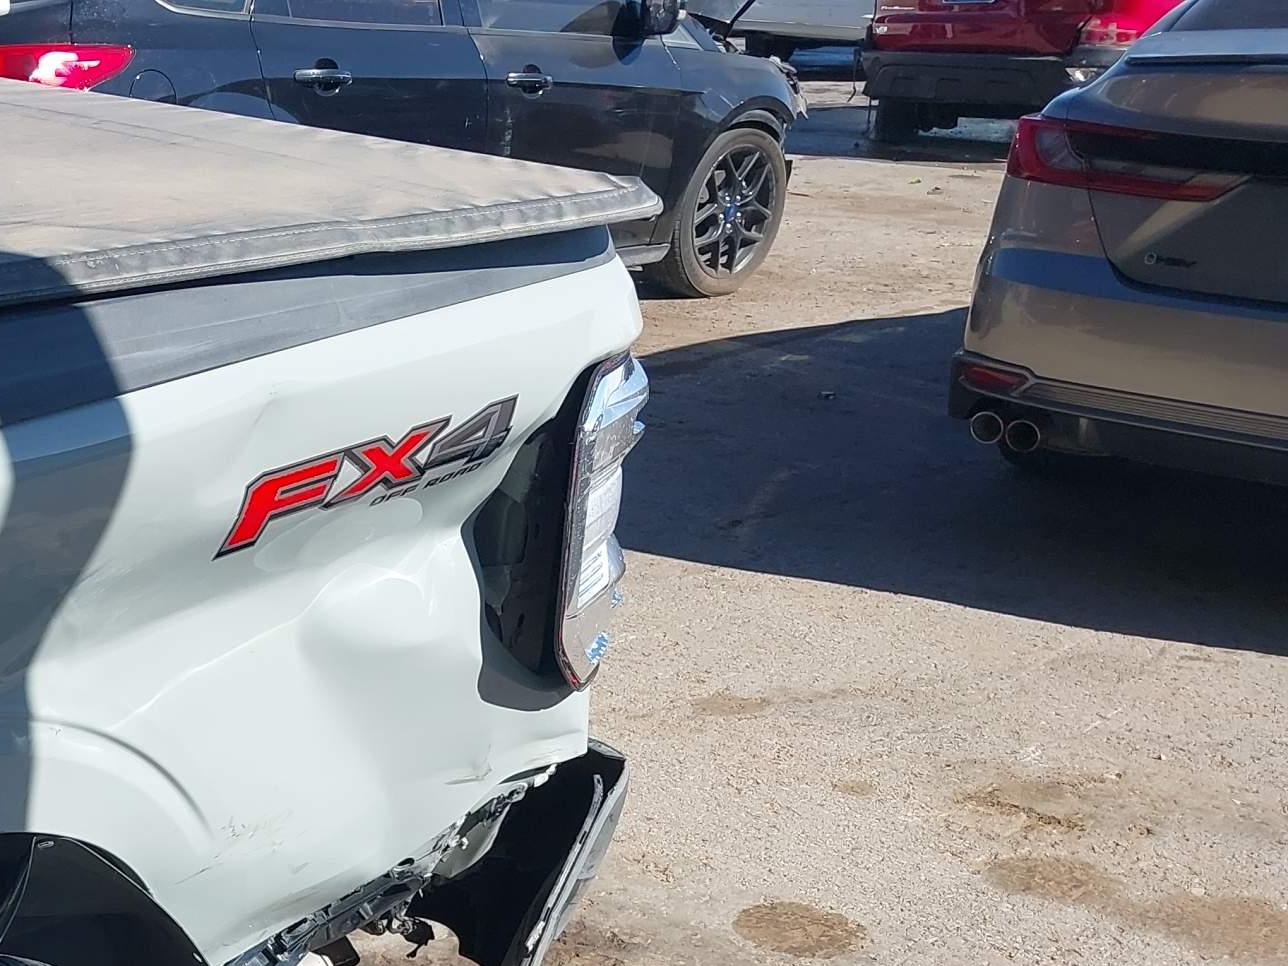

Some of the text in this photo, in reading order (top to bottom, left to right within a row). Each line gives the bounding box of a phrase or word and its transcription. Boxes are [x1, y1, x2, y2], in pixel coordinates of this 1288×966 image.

[212, 394, 520, 561] FX4
[369, 462, 482, 507] OFF ROAD
